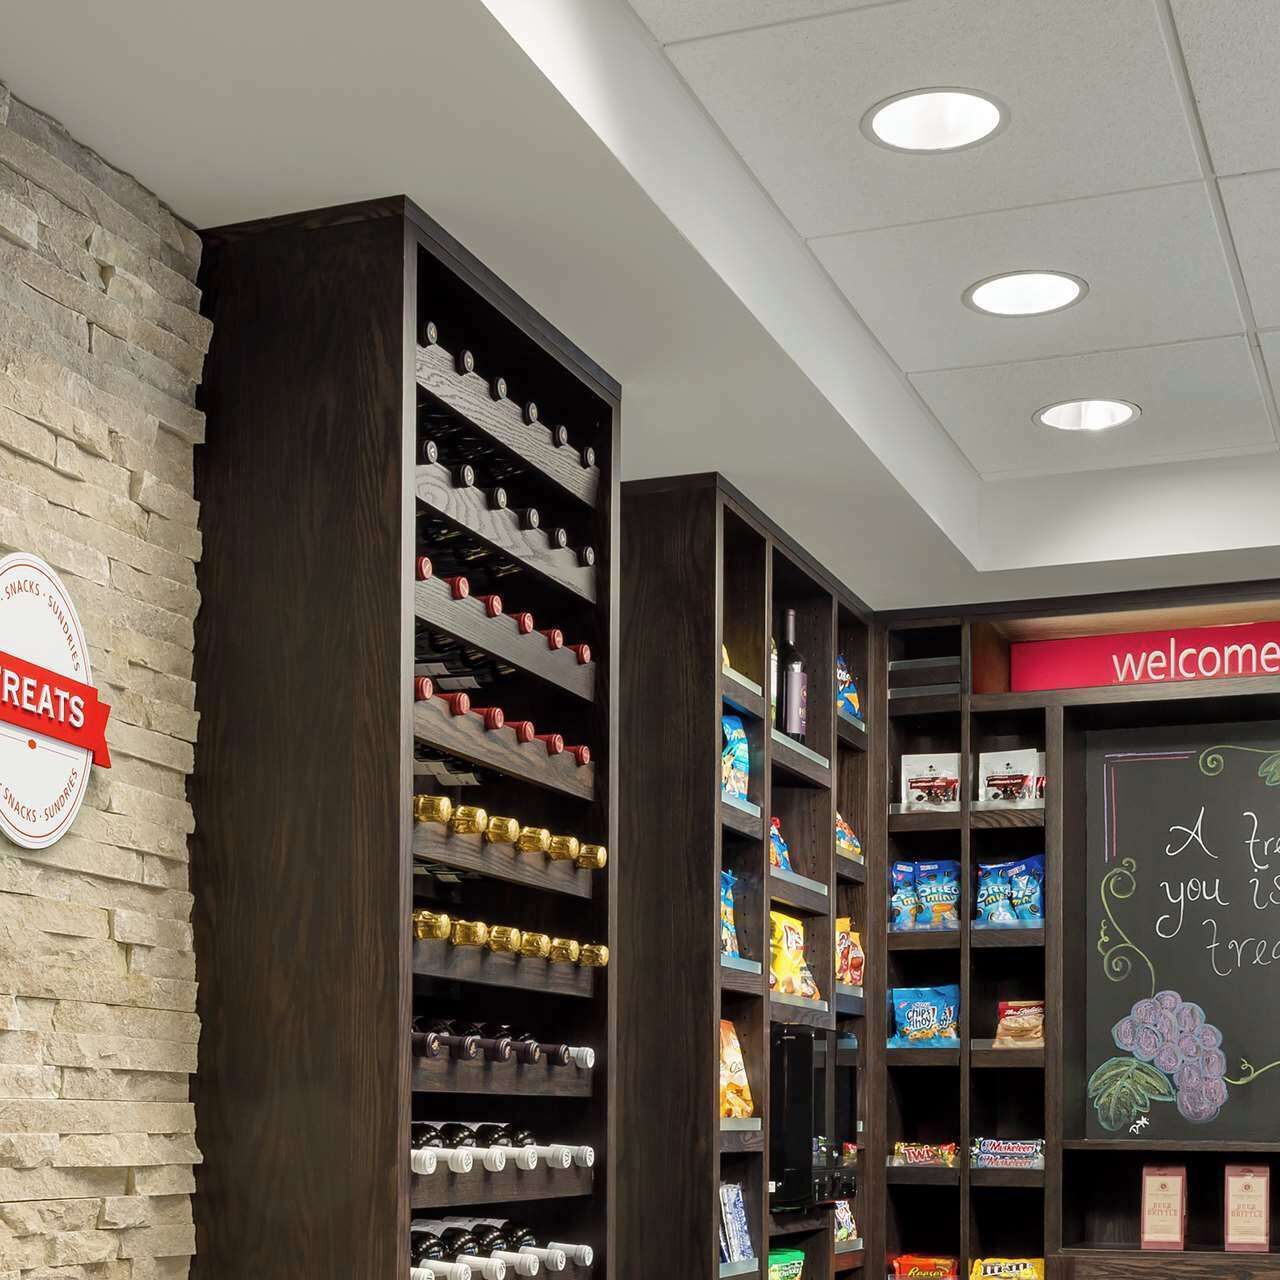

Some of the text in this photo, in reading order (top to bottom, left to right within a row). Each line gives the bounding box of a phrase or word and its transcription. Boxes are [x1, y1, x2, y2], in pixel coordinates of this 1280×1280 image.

[5, 578, 41, 599] SNACKS
[47, 595, 82, 672] SUNDRIES
[1112, 638, 1280, 682] welcome
[3, 787, 37, 824] SNACKS
[44, 767, 79, 822] SUNDRIES
[1165, 807, 1218, 859] A
[1156, 876, 1229, 938] you
